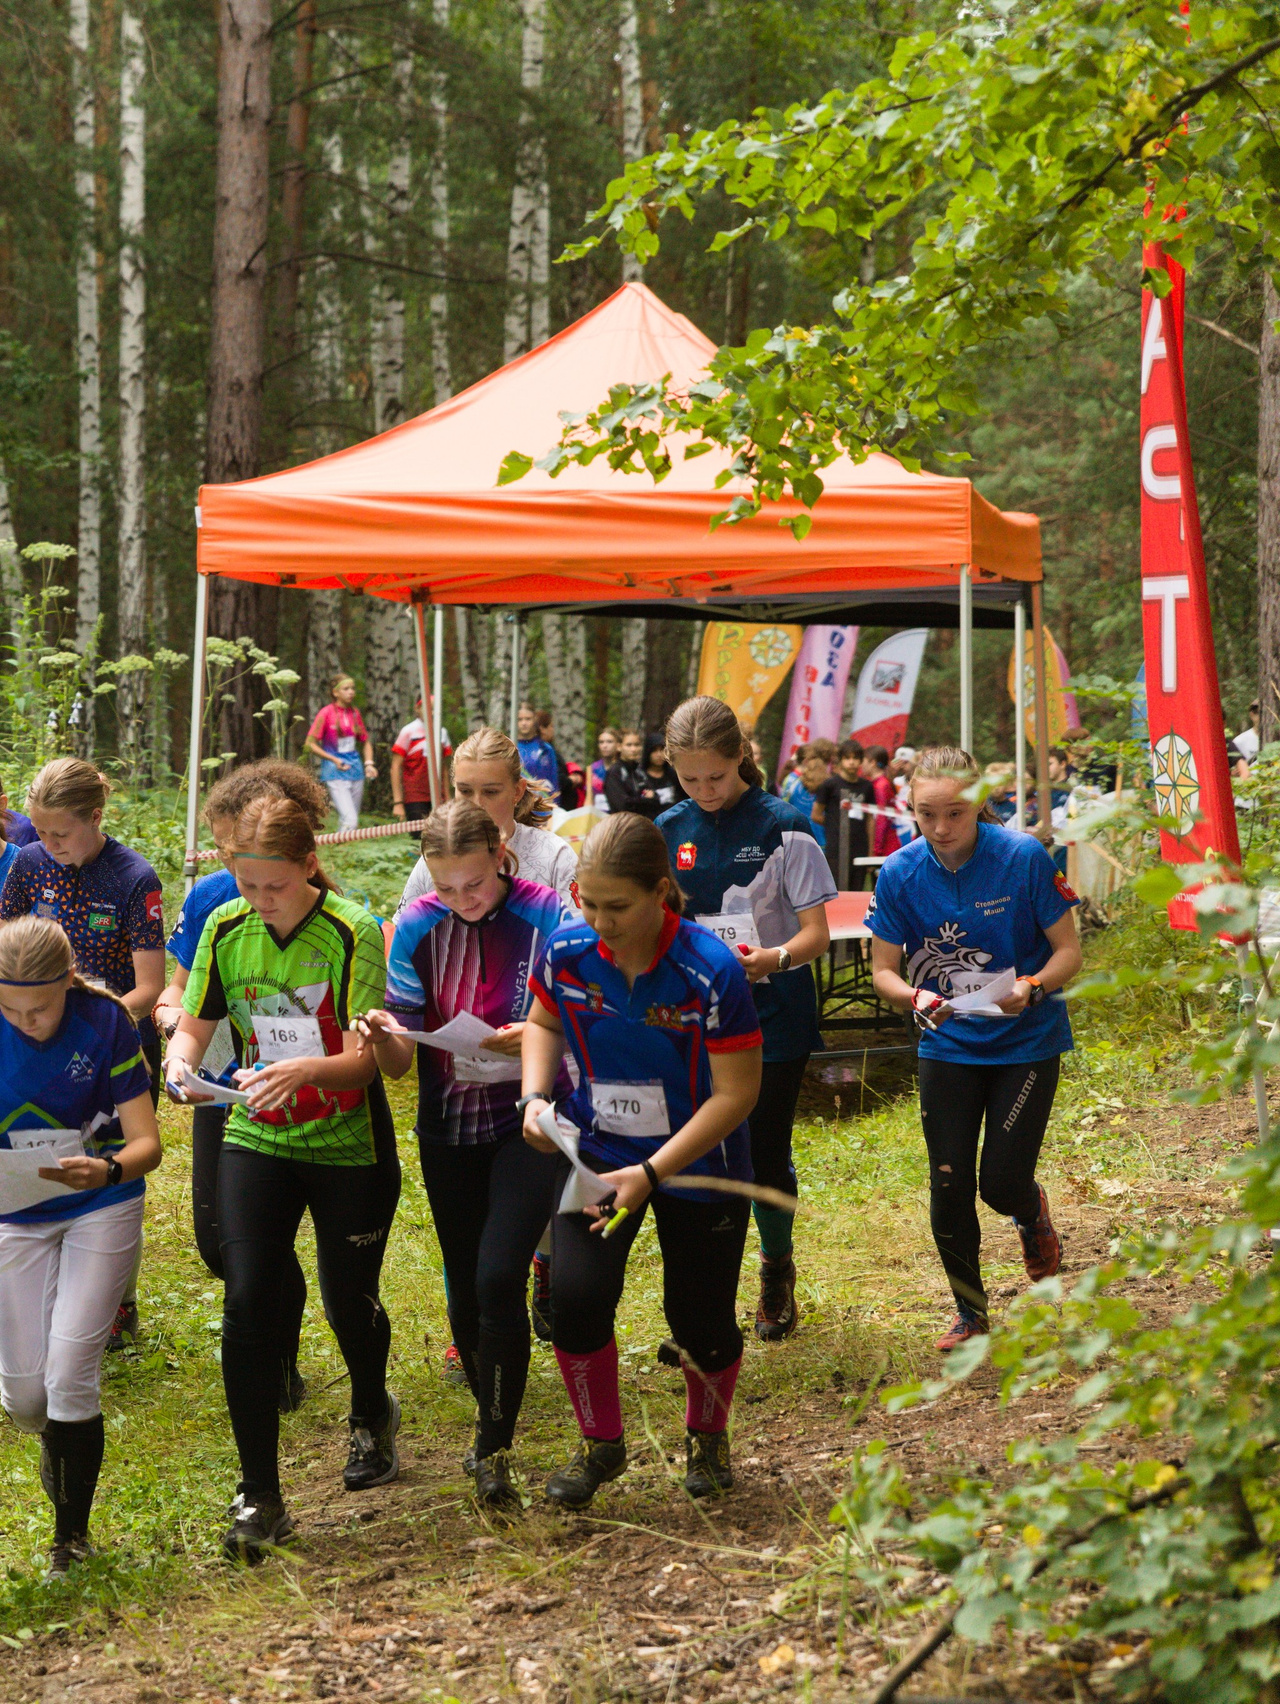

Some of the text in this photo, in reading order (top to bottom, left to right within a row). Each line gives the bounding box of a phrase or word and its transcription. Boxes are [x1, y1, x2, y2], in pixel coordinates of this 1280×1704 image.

[975, 896, 1011, 908] Степанова
[984, 906, 1005, 916] Маша
[93, 916, 110, 925] SFR
[713, 927, 736, 940] 79
[245, 986, 257, 1001] N
[511, 961, 528, 1019] ARSWEAR
[269, 1029, 298, 1043] 168
[610, 1099, 641, 1114] 170
[1003, 1070, 1037, 1132] noname
